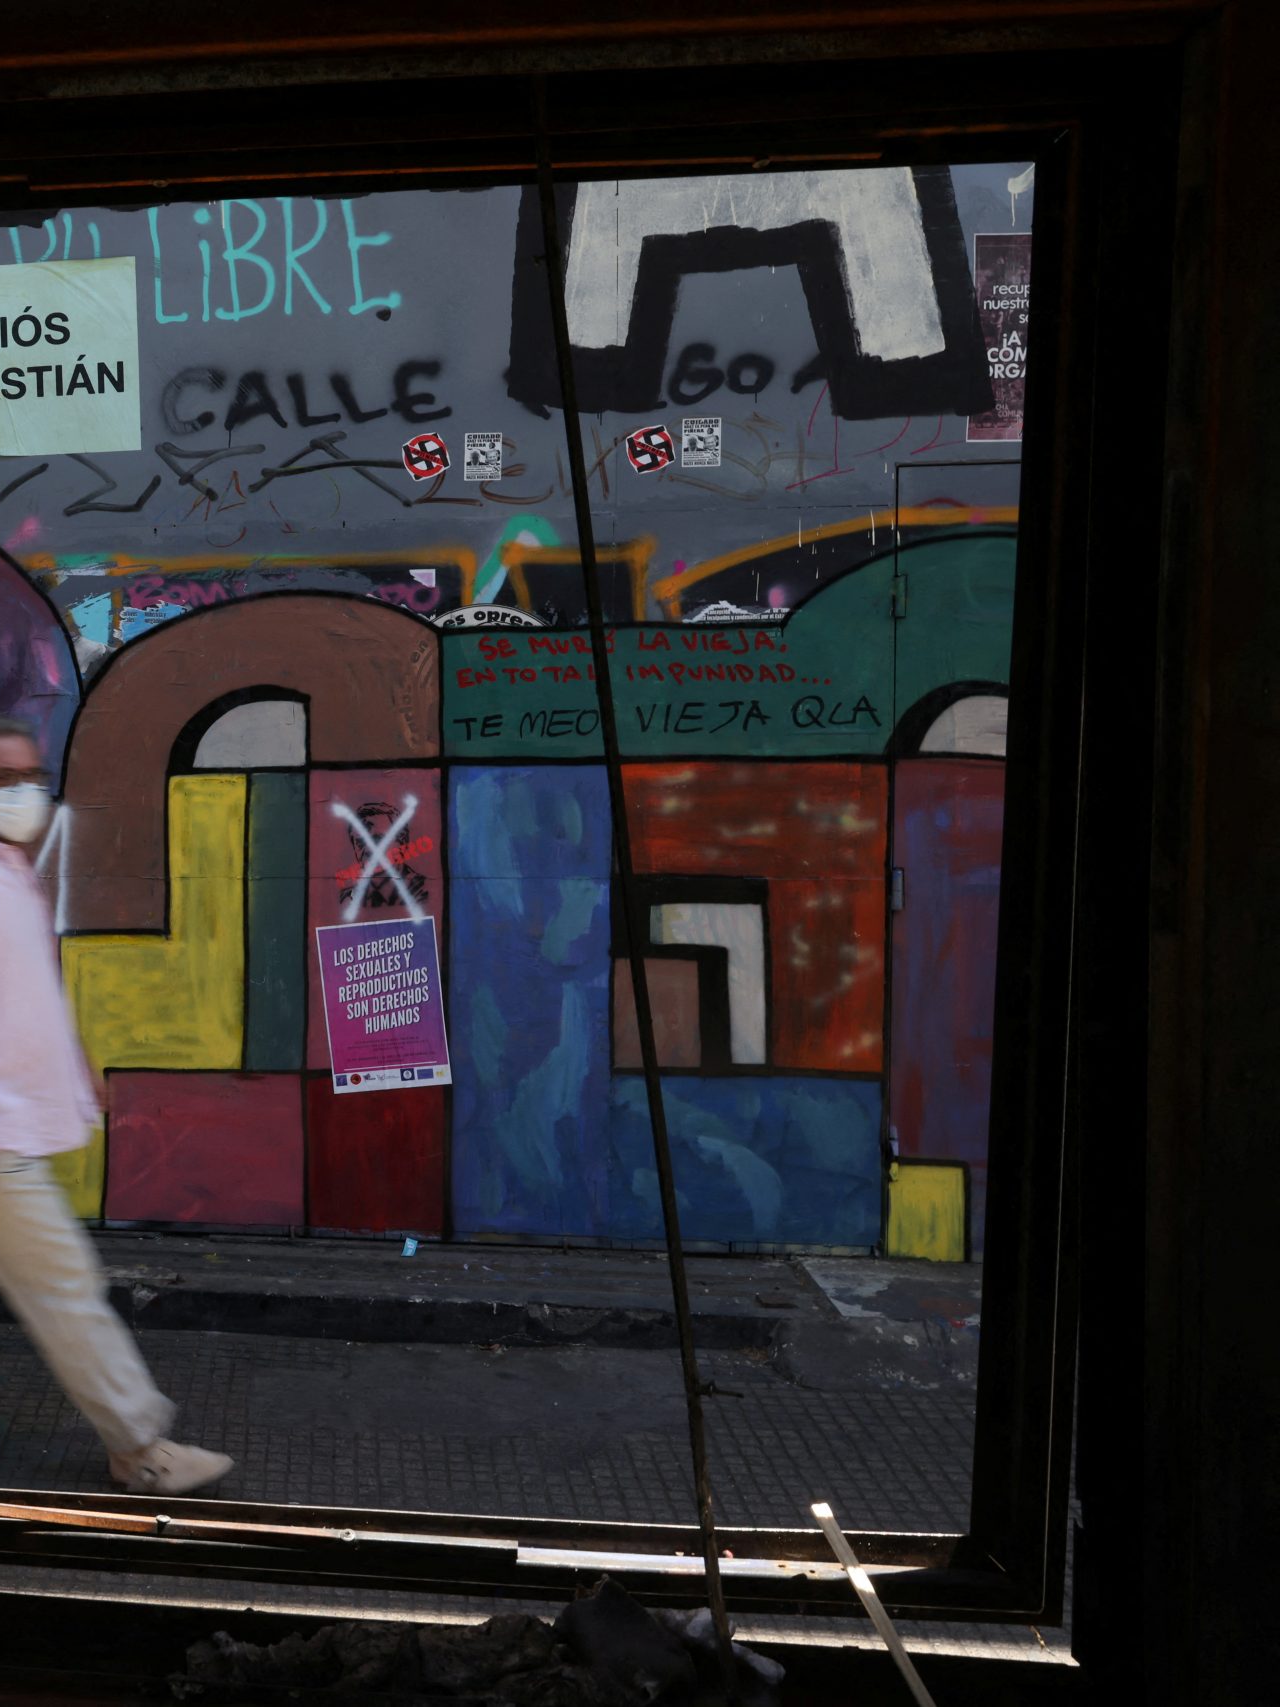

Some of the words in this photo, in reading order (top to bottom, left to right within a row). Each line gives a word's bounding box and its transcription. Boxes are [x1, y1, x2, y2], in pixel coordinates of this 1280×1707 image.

[162, 360, 453, 437] CALLE
[478, 635, 518, 662] SE
[638, 630, 673, 651] LA
[456, 667, 497, 689] EN
[453, 714, 504, 742] TE
[519, 708, 600, 740] MEO
[635, 700, 772, 734] VIEJA
[333, 946, 354, 967] LOS
[357, 932, 414, 961] DERECHOS
[346, 954, 401, 982] SEXUALES
[403, 951, 411, 969] Y
[338, 966, 428, 1003] REPRODUCTIVOS
[347, 999, 369, 1020] SON
[372, 985, 429, 1014] DERECHOS
[365, 1006, 420, 1035] HUMANOS
